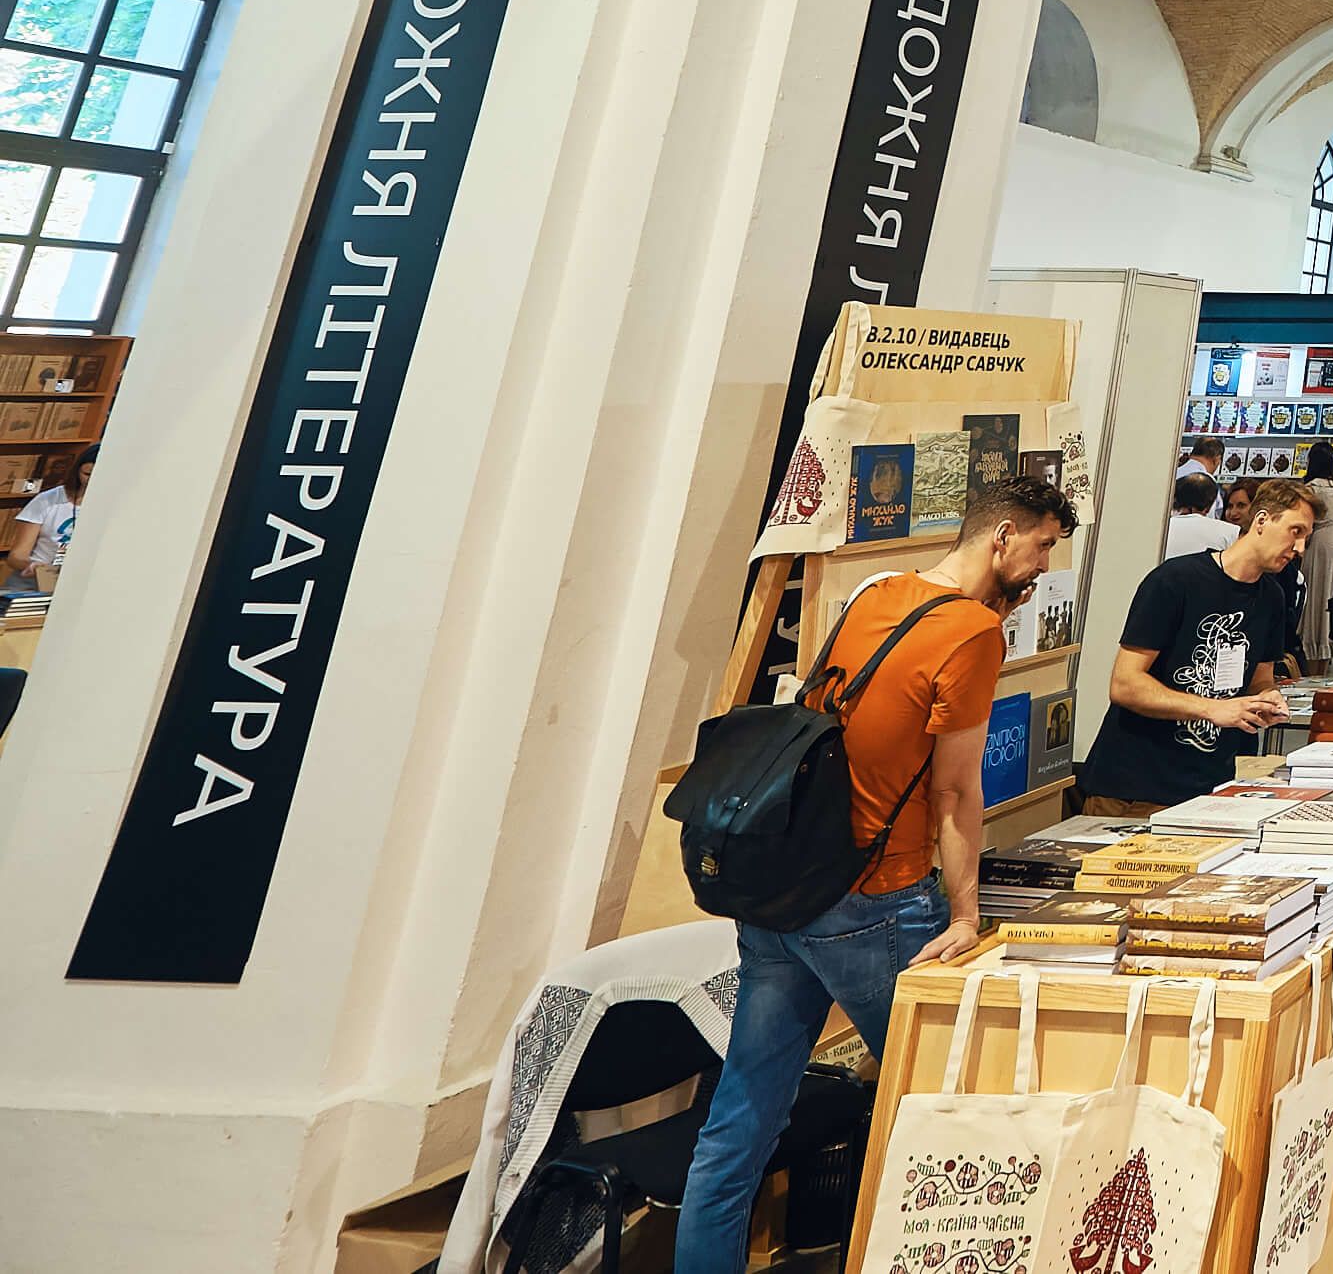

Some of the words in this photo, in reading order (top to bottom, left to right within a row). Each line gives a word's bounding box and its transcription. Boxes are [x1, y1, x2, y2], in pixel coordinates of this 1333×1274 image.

[928, 329, 1011, 350] ВИДАВЕЦЬ
[861, 351, 964, 373] ОЛЕКСАНДР
[966, 355, 1026, 373] САВЧУК
[173, 240, 398, 829] ЛІТЕРАТУРА
